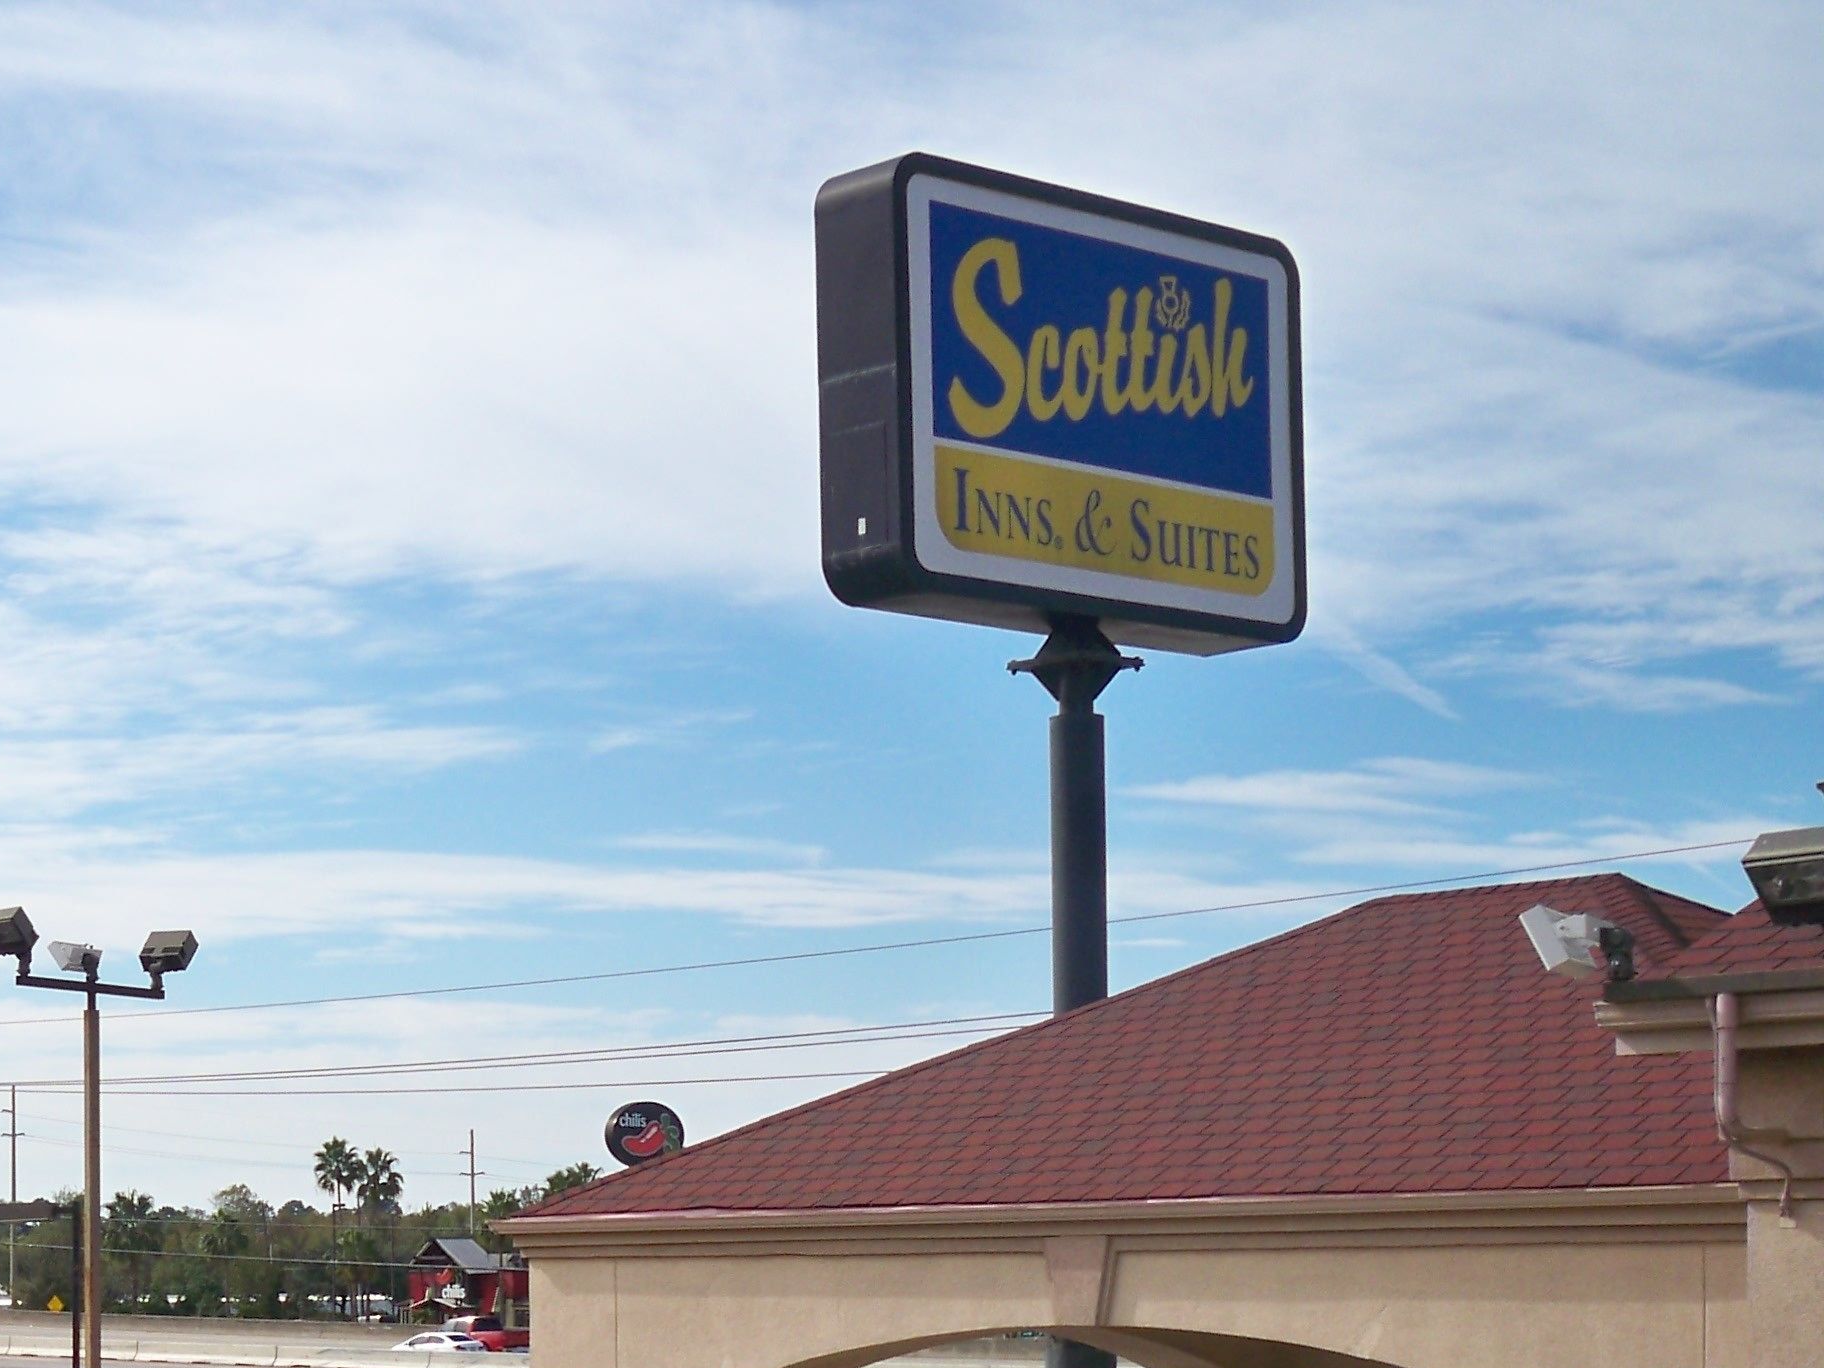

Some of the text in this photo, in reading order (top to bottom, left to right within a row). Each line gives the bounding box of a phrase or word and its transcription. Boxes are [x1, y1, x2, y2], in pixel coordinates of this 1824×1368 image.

[948, 237, 1254, 438] Scottish
[1075, 488, 1117, 556] &
[1129, 498, 1260, 580] SUITES
